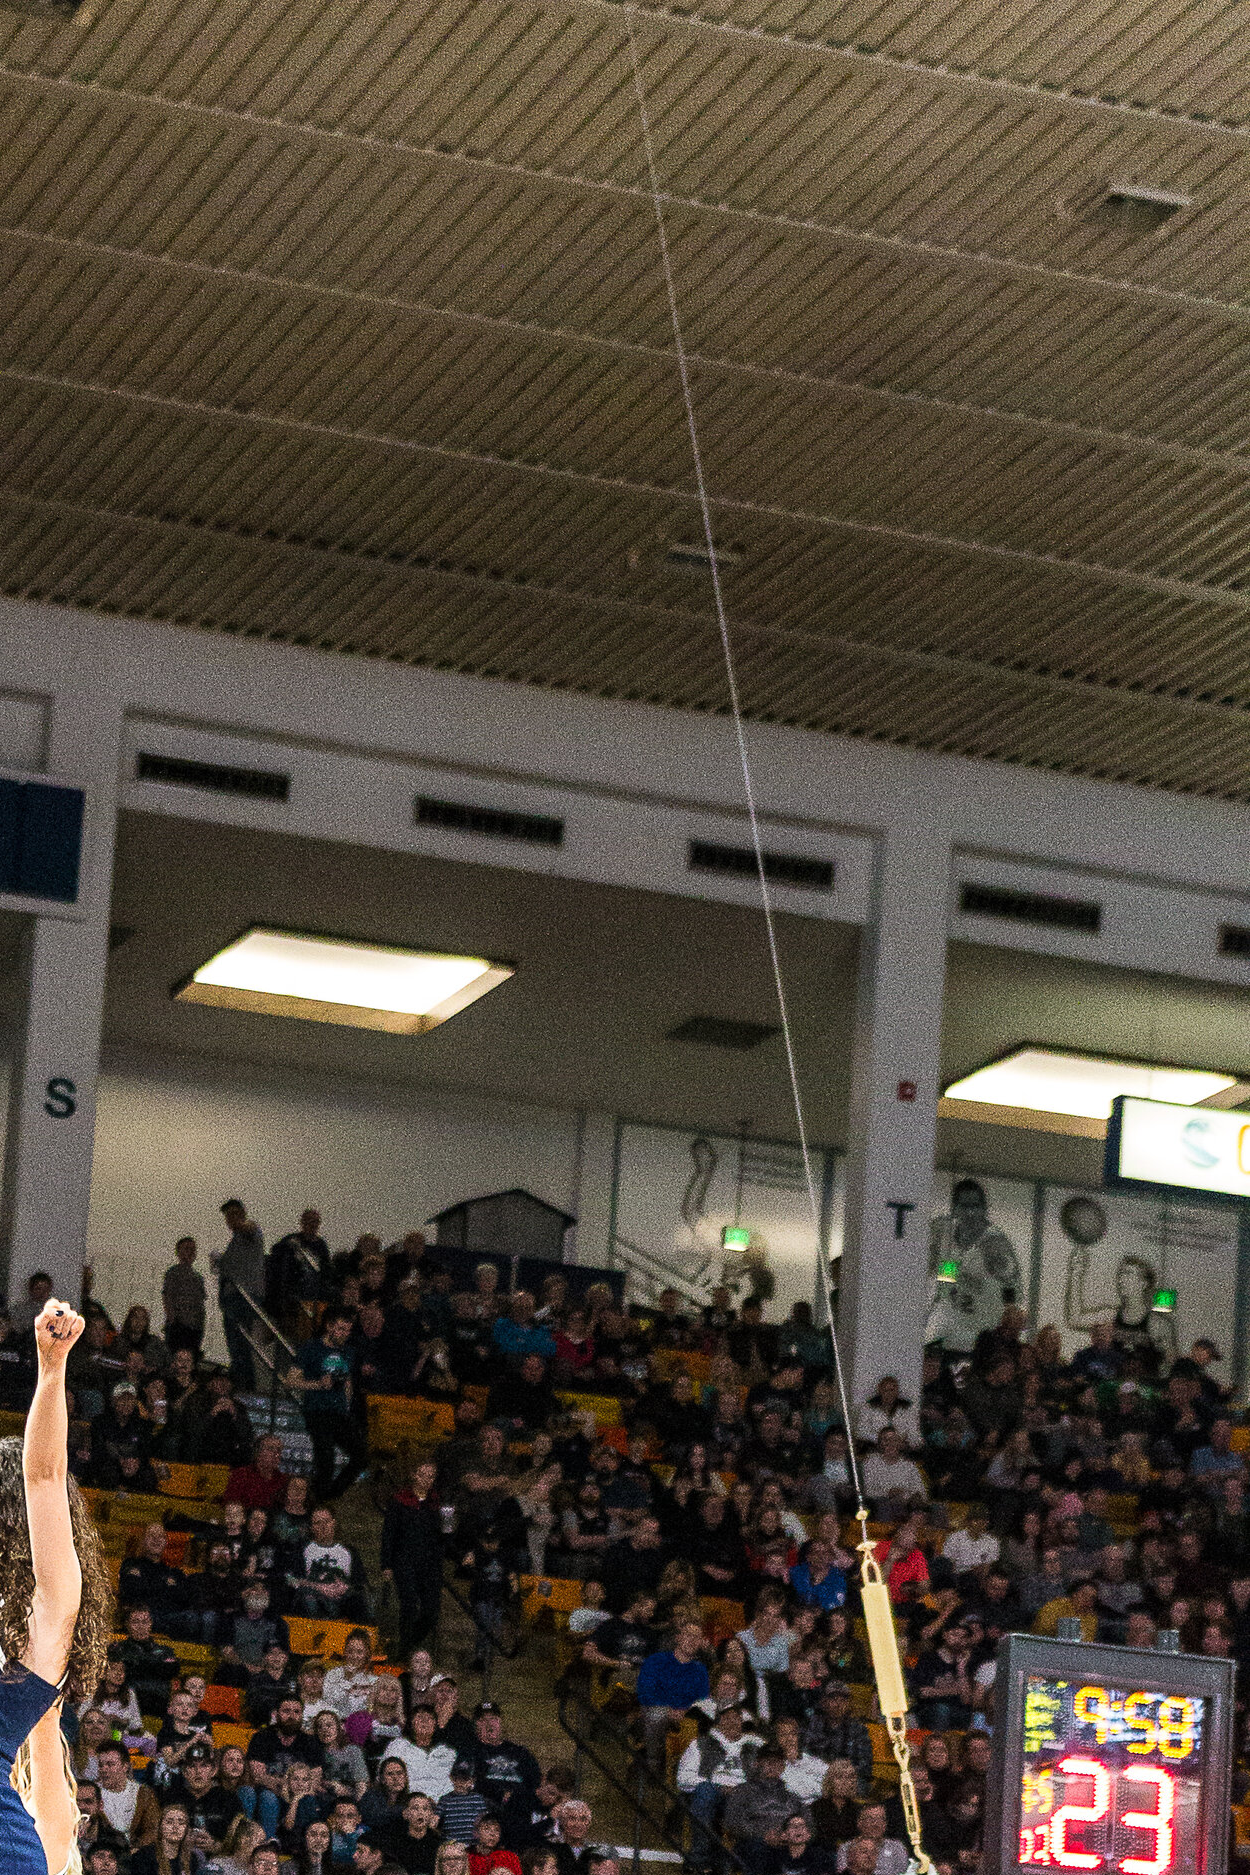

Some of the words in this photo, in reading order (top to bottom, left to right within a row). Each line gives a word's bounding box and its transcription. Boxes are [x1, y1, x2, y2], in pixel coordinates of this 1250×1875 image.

[44, 1077, 77, 1119] S
[886, 1201, 915, 1239] T
[1074, 1687, 1195, 1759] 9:58
